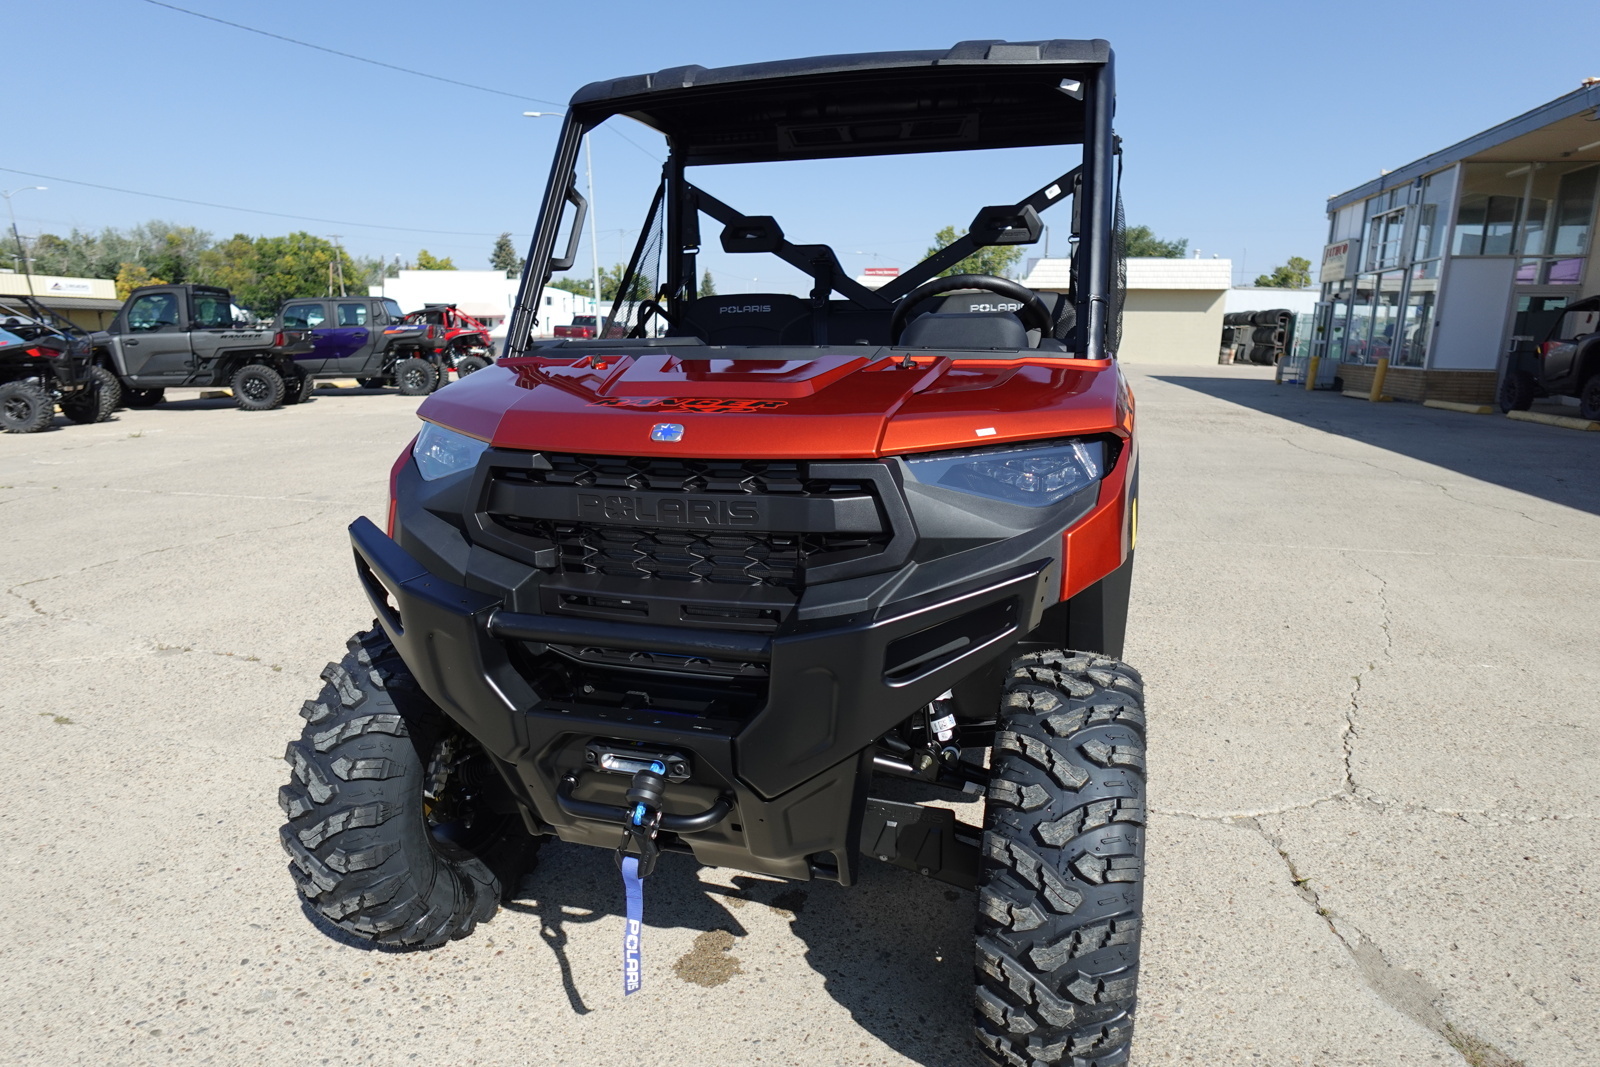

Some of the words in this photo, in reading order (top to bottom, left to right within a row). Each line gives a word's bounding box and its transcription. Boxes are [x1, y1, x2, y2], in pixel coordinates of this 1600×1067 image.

[719, 305, 772, 314] POLARIS
[585, 397, 788, 410] RANGER
[577, 493, 760, 526] POLARIS
[625, 918, 641, 991] POLARIS
